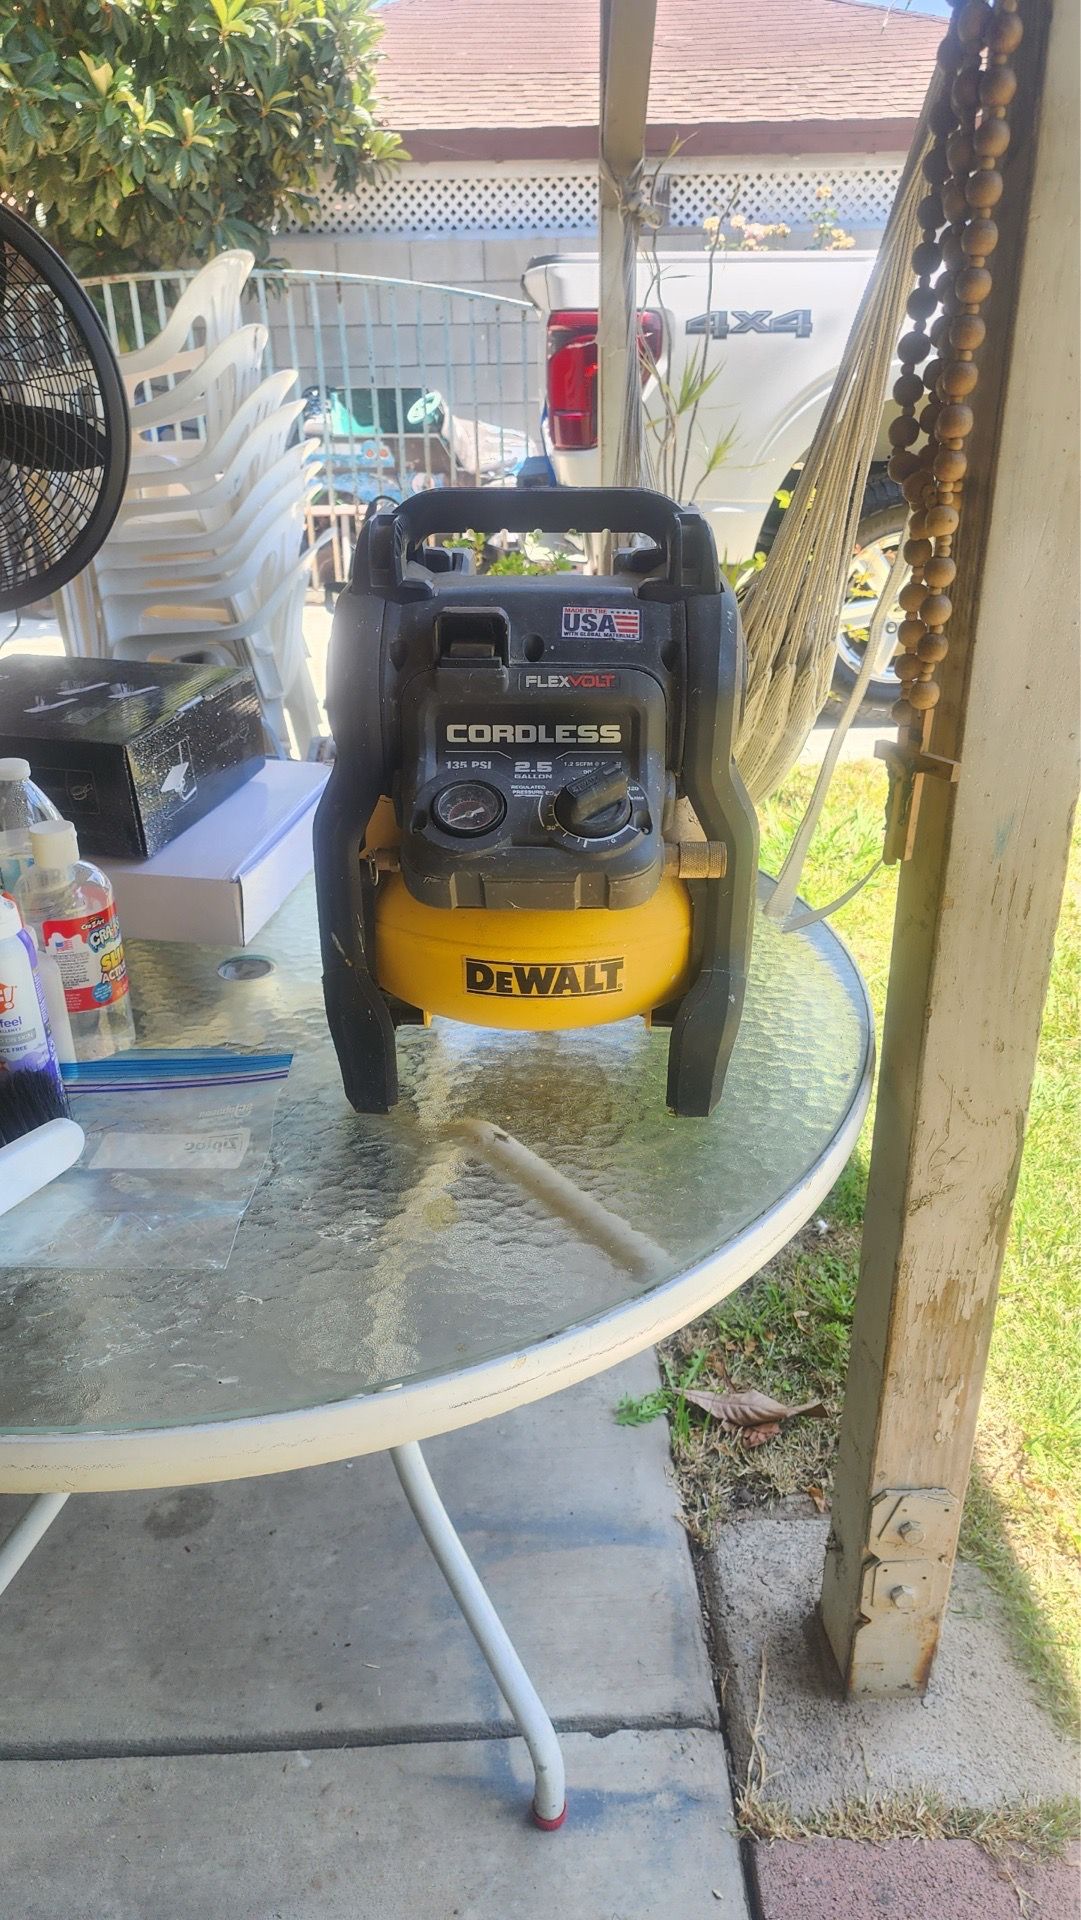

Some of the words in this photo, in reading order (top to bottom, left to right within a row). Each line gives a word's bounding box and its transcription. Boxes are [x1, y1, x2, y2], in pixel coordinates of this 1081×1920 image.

[563, 614, 616, 632] USA
[525, 674, 615, 688] FLEXVOLT
[446, 724, 622, 743] CORDLESS
[446, 761, 467, 769] 135
[471, 761, 492, 769] PSI
[514, 761, 552, 772] 2.5
